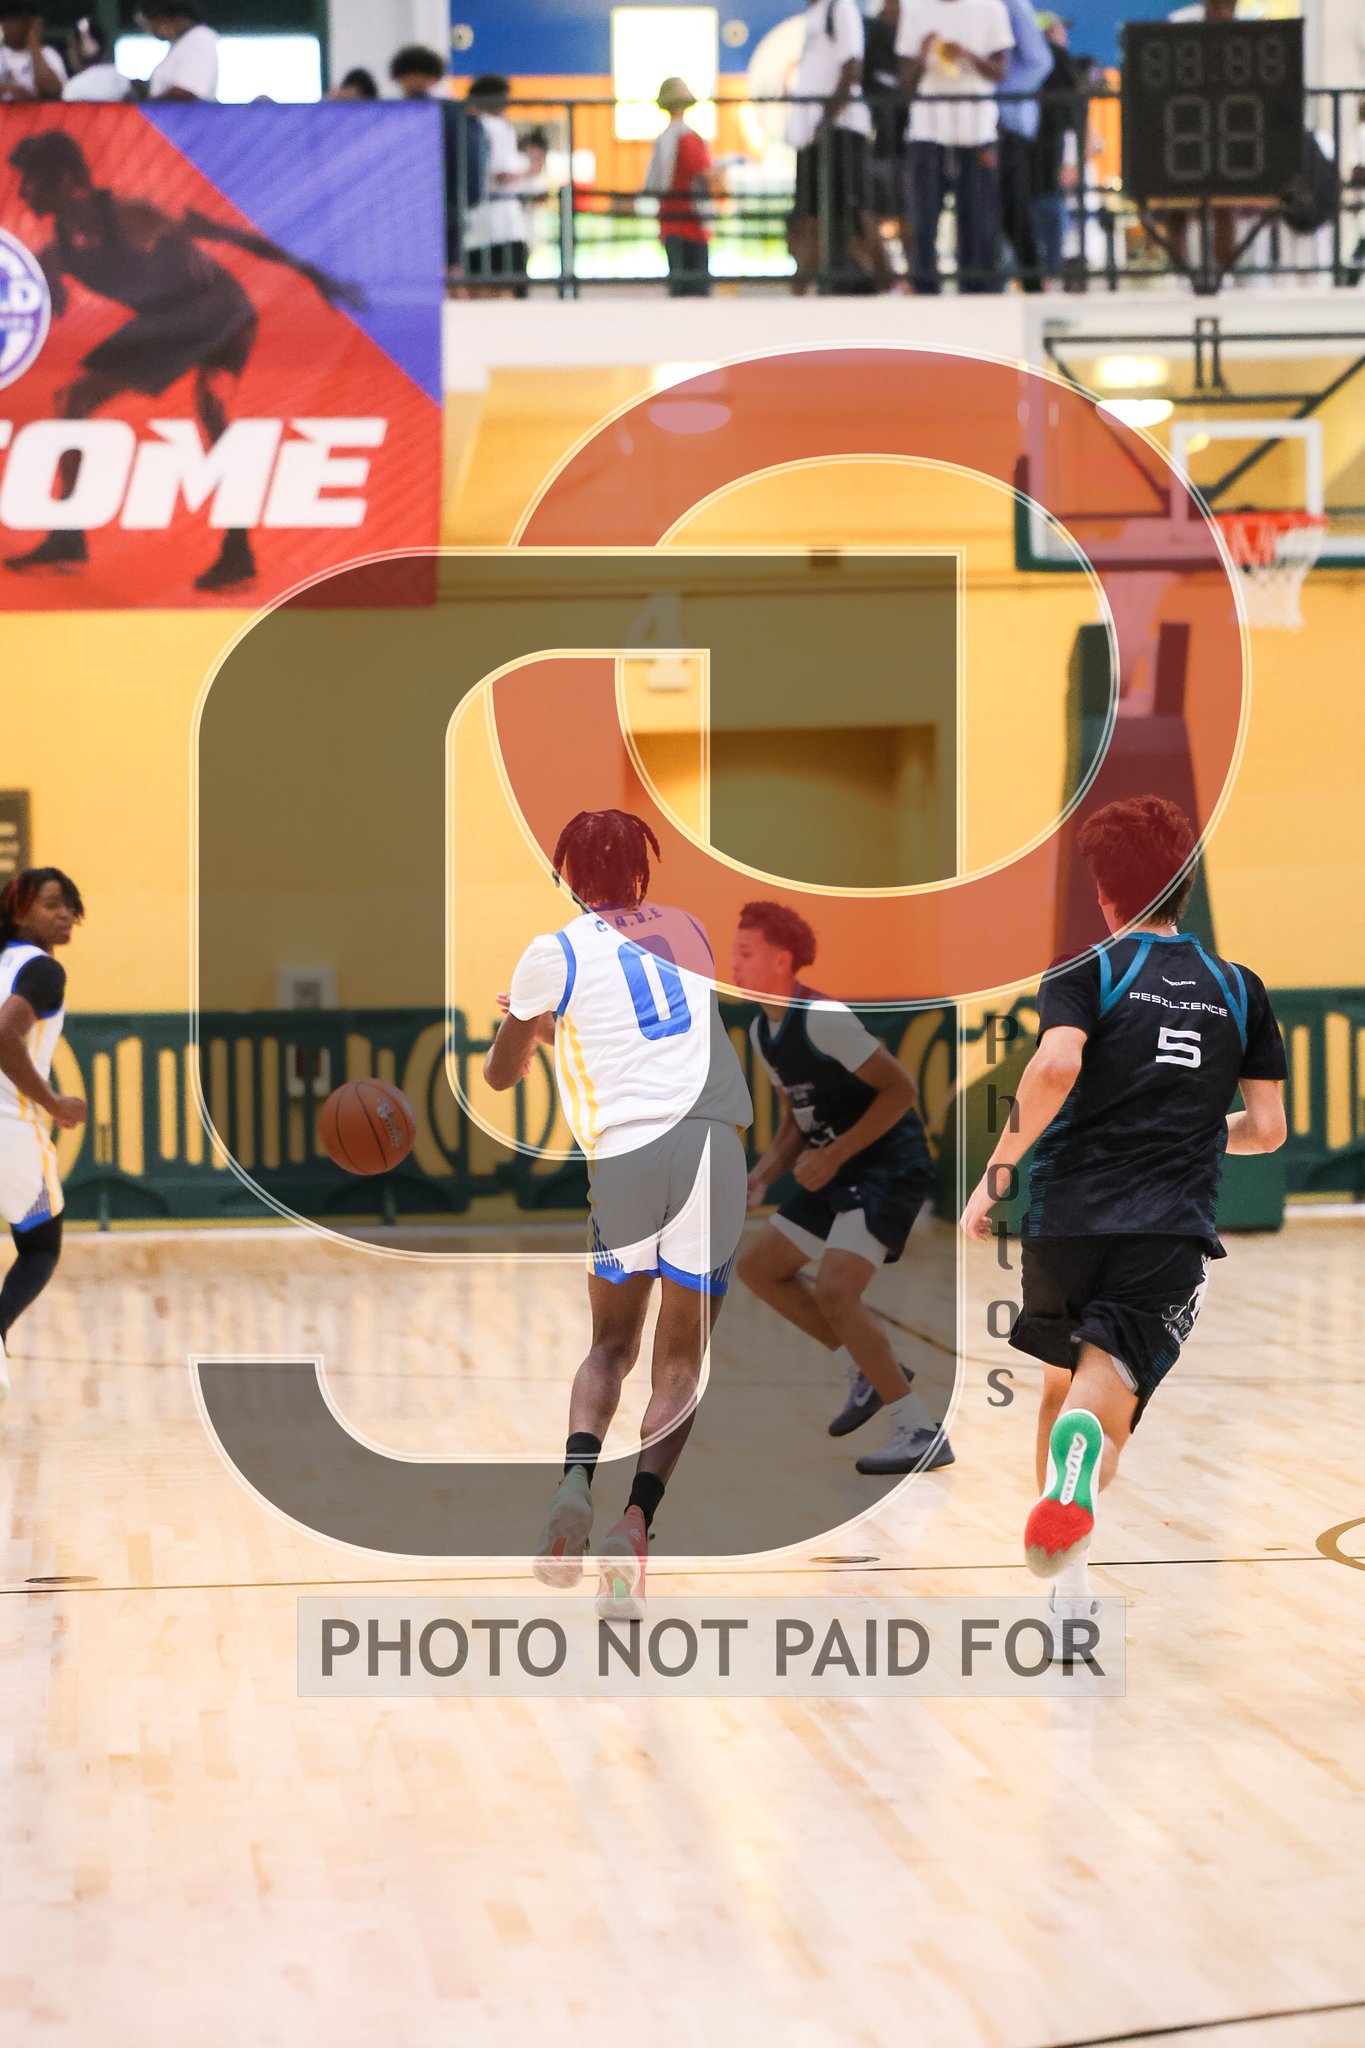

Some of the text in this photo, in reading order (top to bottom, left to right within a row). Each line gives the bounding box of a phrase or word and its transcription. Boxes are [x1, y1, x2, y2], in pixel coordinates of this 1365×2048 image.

[0, 417, 388, 530] OME
[617, 934, 692, 1041] 0
[1129, 991, 1228, 1018] RESILIENCE
[1155, 1026, 1202, 1069] 5
